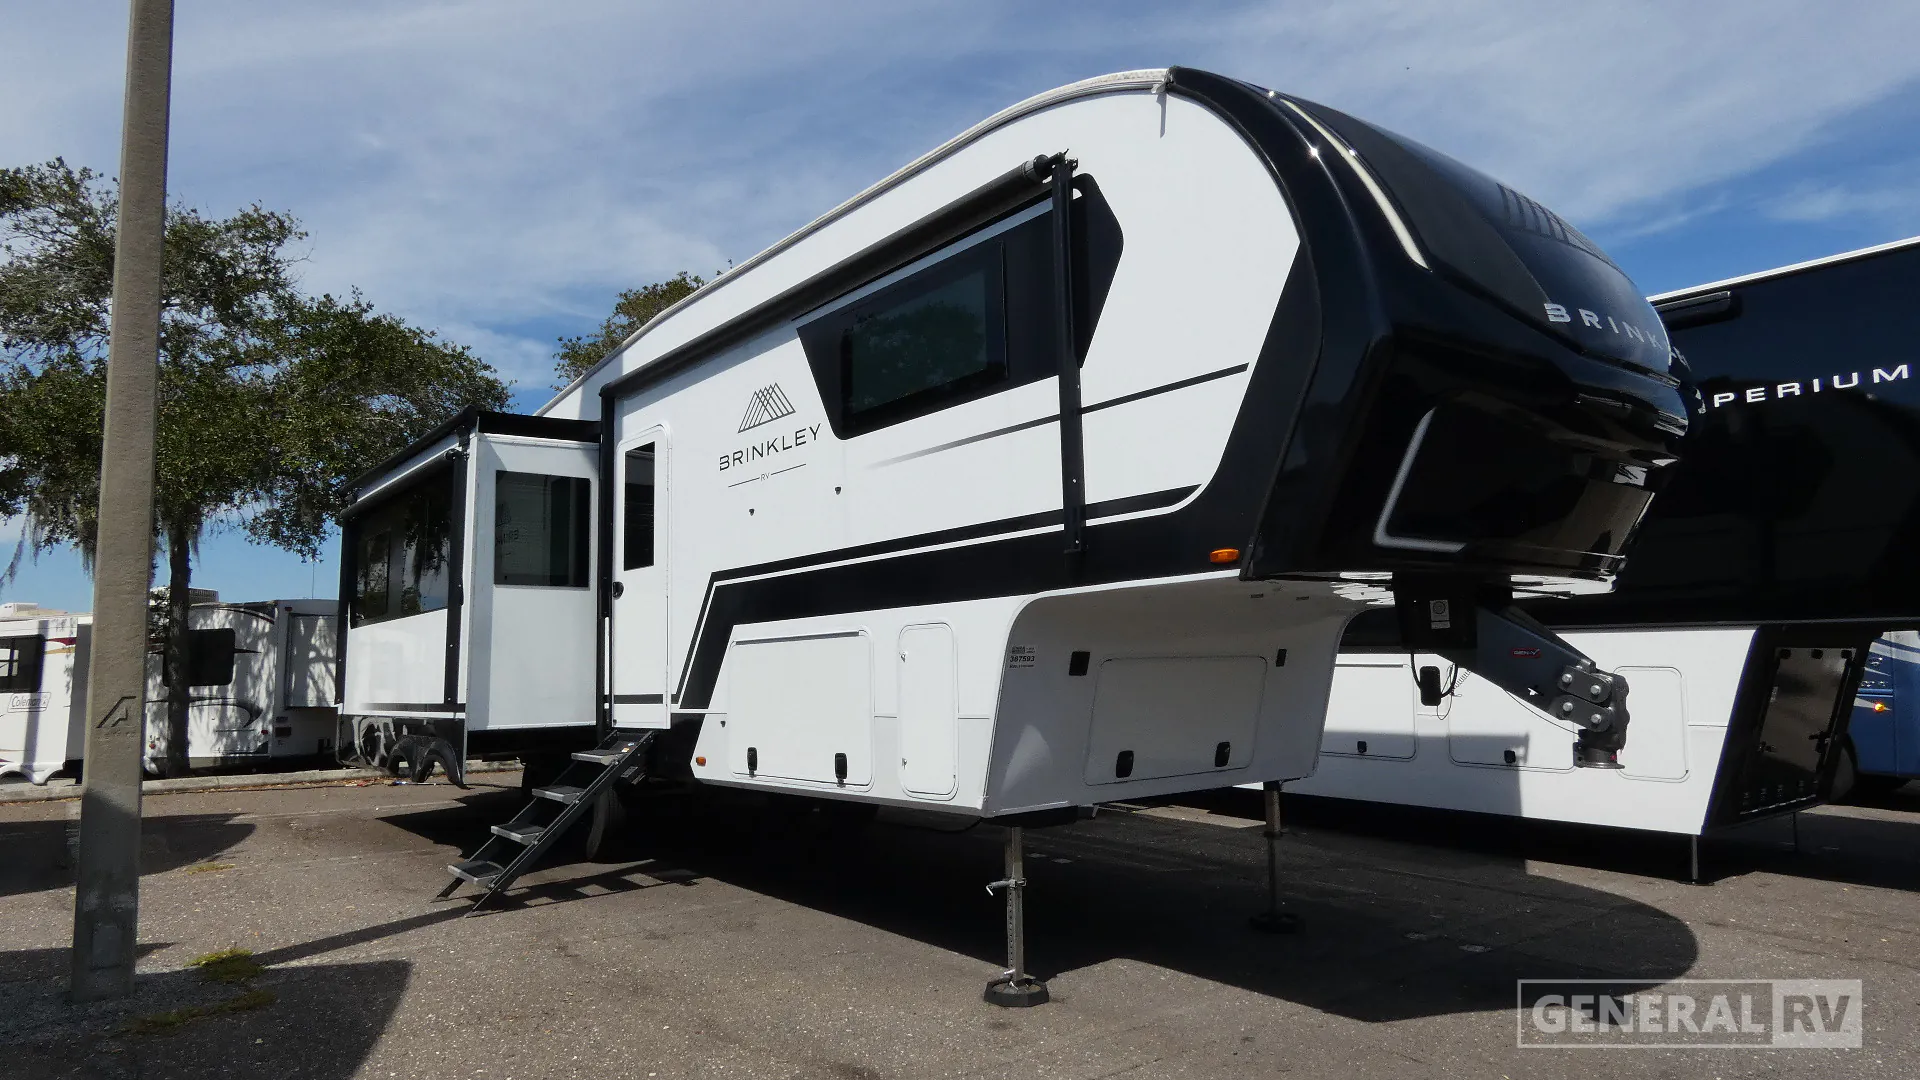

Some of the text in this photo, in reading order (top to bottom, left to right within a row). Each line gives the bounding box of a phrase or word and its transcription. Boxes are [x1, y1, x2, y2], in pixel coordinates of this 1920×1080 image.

[1543, 303, 1664, 351] BRINK
[1713, 364, 1910, 408] PERIUM
[719, 422, 821, 471] BRINKLEY
[760, 472, 770, 481] RV
